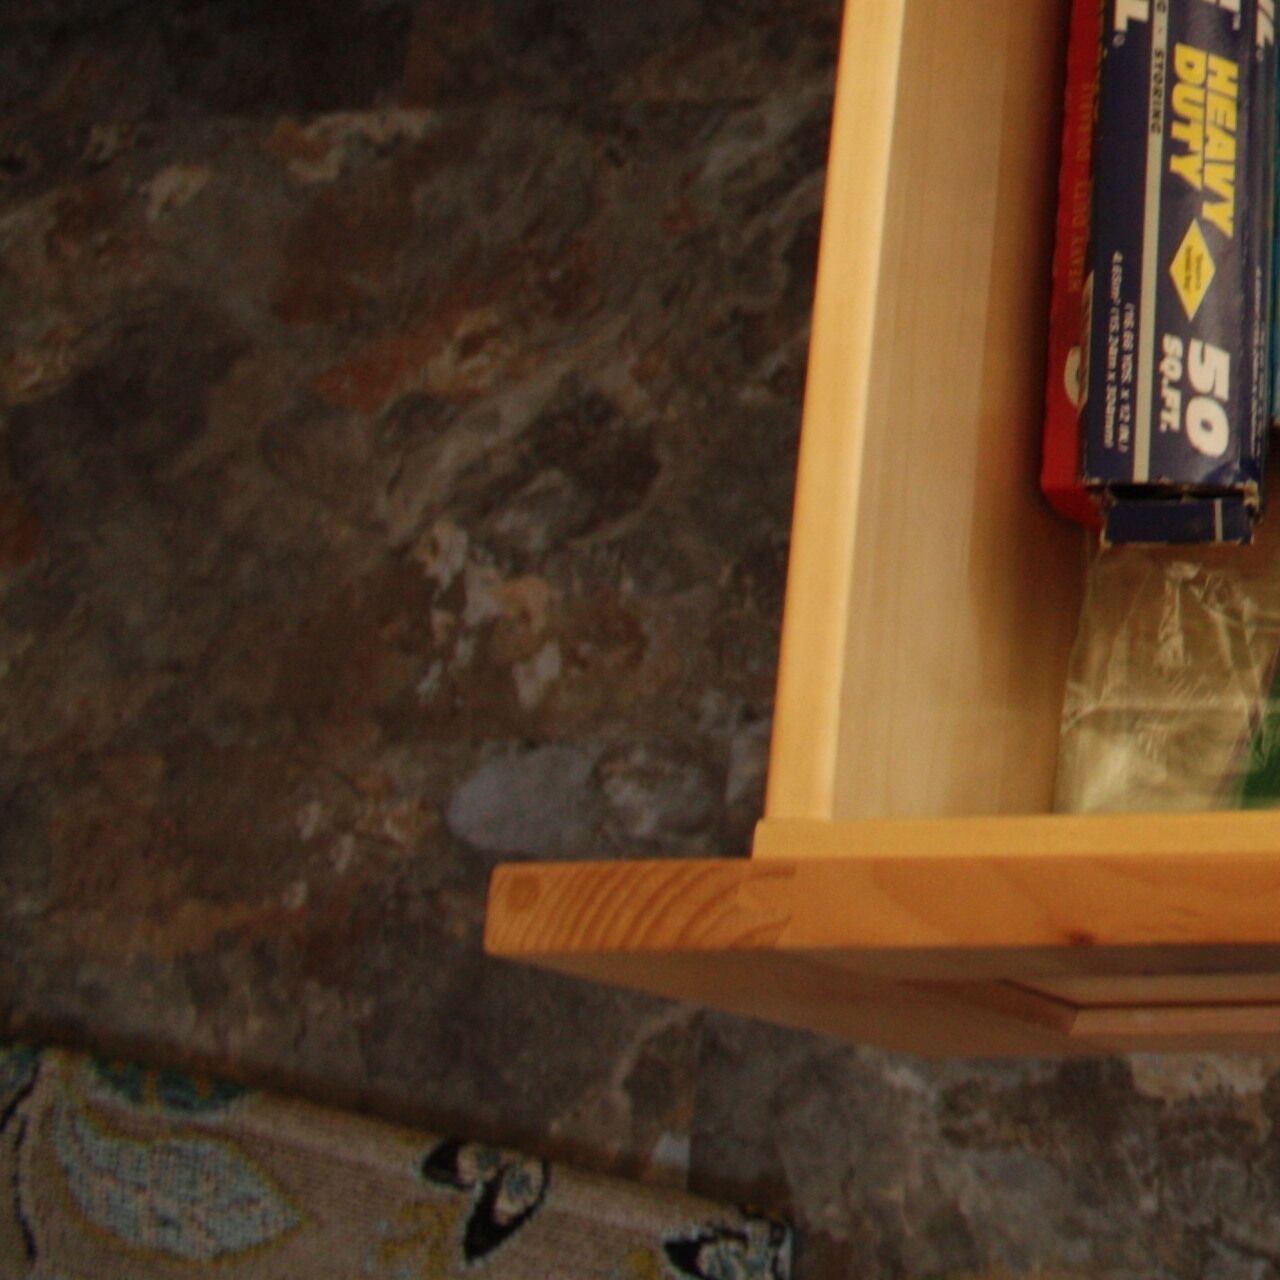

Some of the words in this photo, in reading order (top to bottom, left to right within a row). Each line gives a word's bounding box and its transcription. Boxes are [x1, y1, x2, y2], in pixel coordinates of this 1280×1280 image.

[1150, 47, 1166, 135] STORING
[1169, 41, 1207, 191] DUTY
[1201, 53, 1241, 239] HEAVY
[1185, 337, 1231, 458] 50
